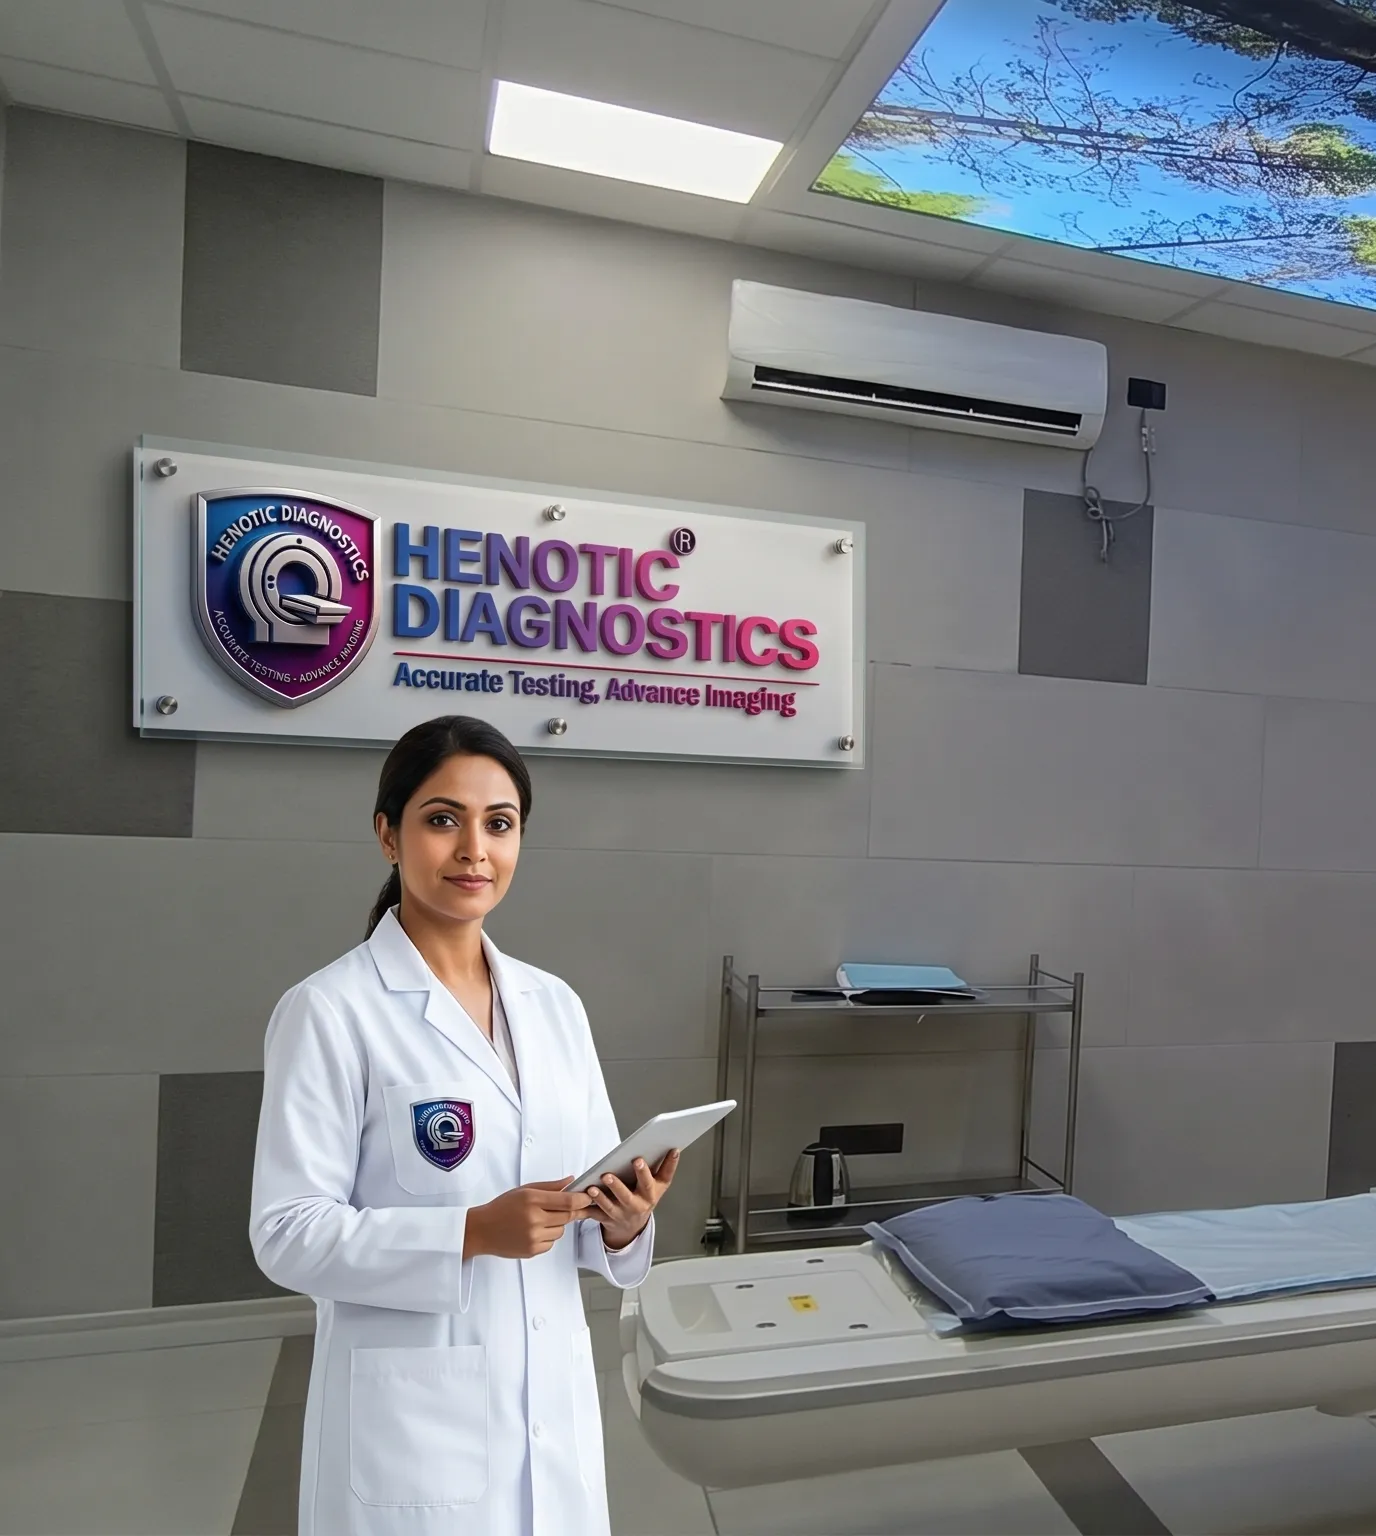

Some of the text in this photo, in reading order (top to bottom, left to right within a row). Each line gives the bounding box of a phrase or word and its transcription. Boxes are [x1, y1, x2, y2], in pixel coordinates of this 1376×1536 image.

[211, 504, 369, 582] HENOTIC DIAGNOSTICS
[393, 522, 680, 602] HENOTIC
[393, 583, 820, 671] DIAGNOSTICS
[393, 662, 797, 717] Accurate Testing, Advance Imaging
